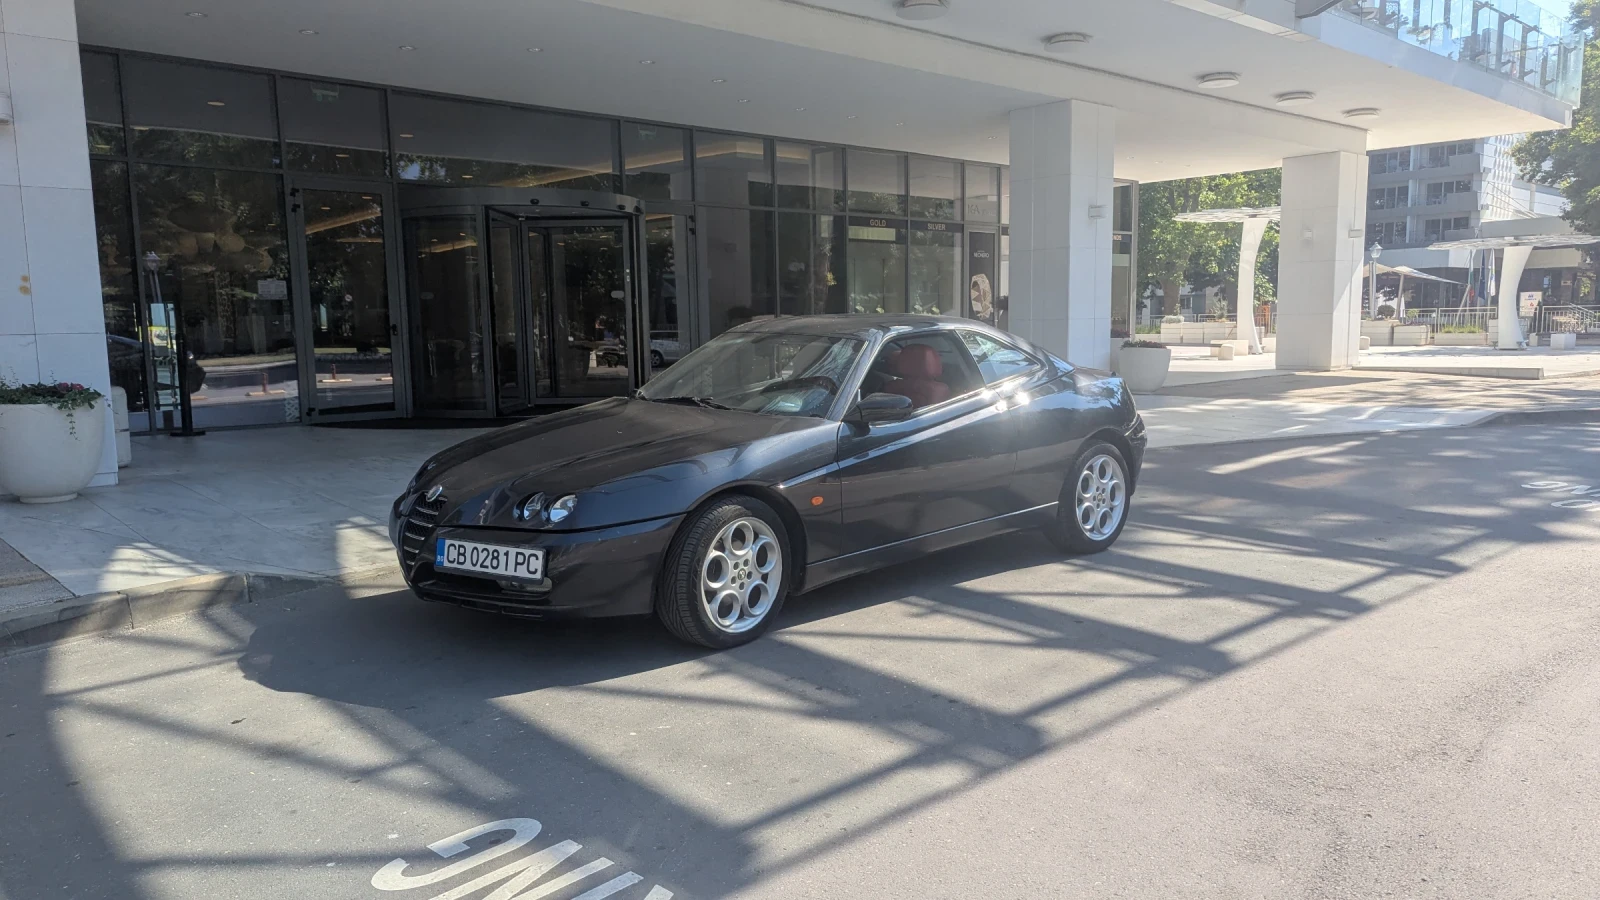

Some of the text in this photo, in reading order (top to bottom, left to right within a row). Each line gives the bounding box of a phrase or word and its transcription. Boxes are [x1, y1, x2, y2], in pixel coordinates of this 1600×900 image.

[869, 219, 886, 227] GOLD
[927, 223, 946, 231] SILVER
[700, 516, 725, 547] UNIROYAL
[446, 543, 539, 575] CB 0281 PC
